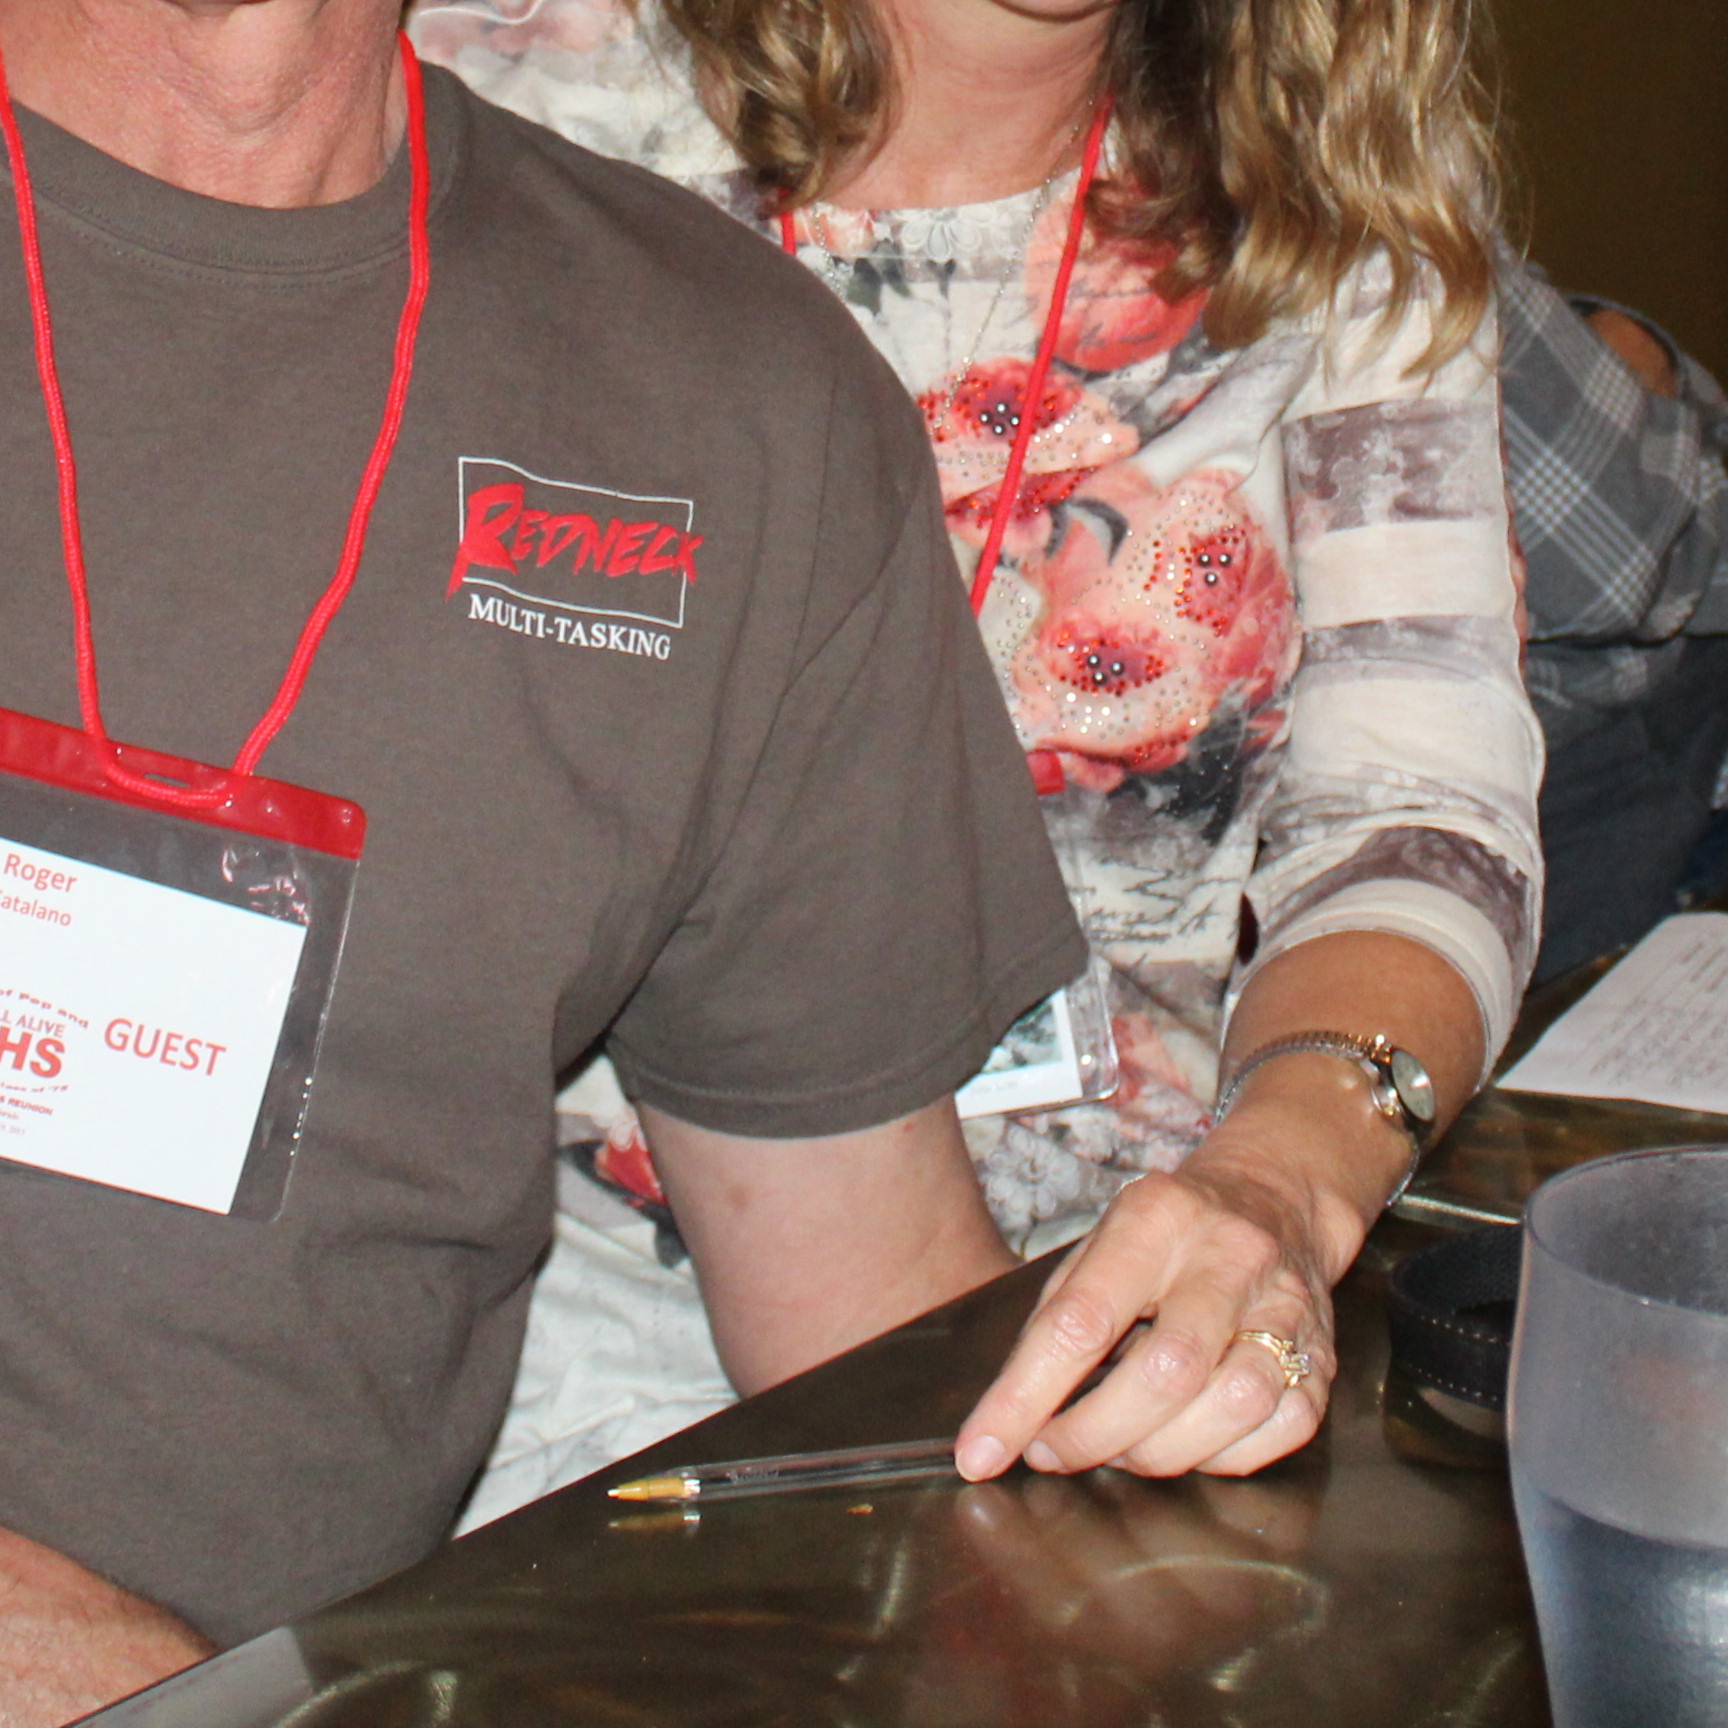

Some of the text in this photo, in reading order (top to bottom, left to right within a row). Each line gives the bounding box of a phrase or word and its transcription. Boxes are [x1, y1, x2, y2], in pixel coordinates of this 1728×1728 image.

[444, 481, 704, 603] REDNECK
[467, 593, 672, 661] MULTI-TASKING
[3, 853, 77, 892] Roger
[16, 1014, 66, 1038] ALIVE
[104, 1017, 227, 1076] GUEST
[7, 1097, 53, 1115] REUNION
